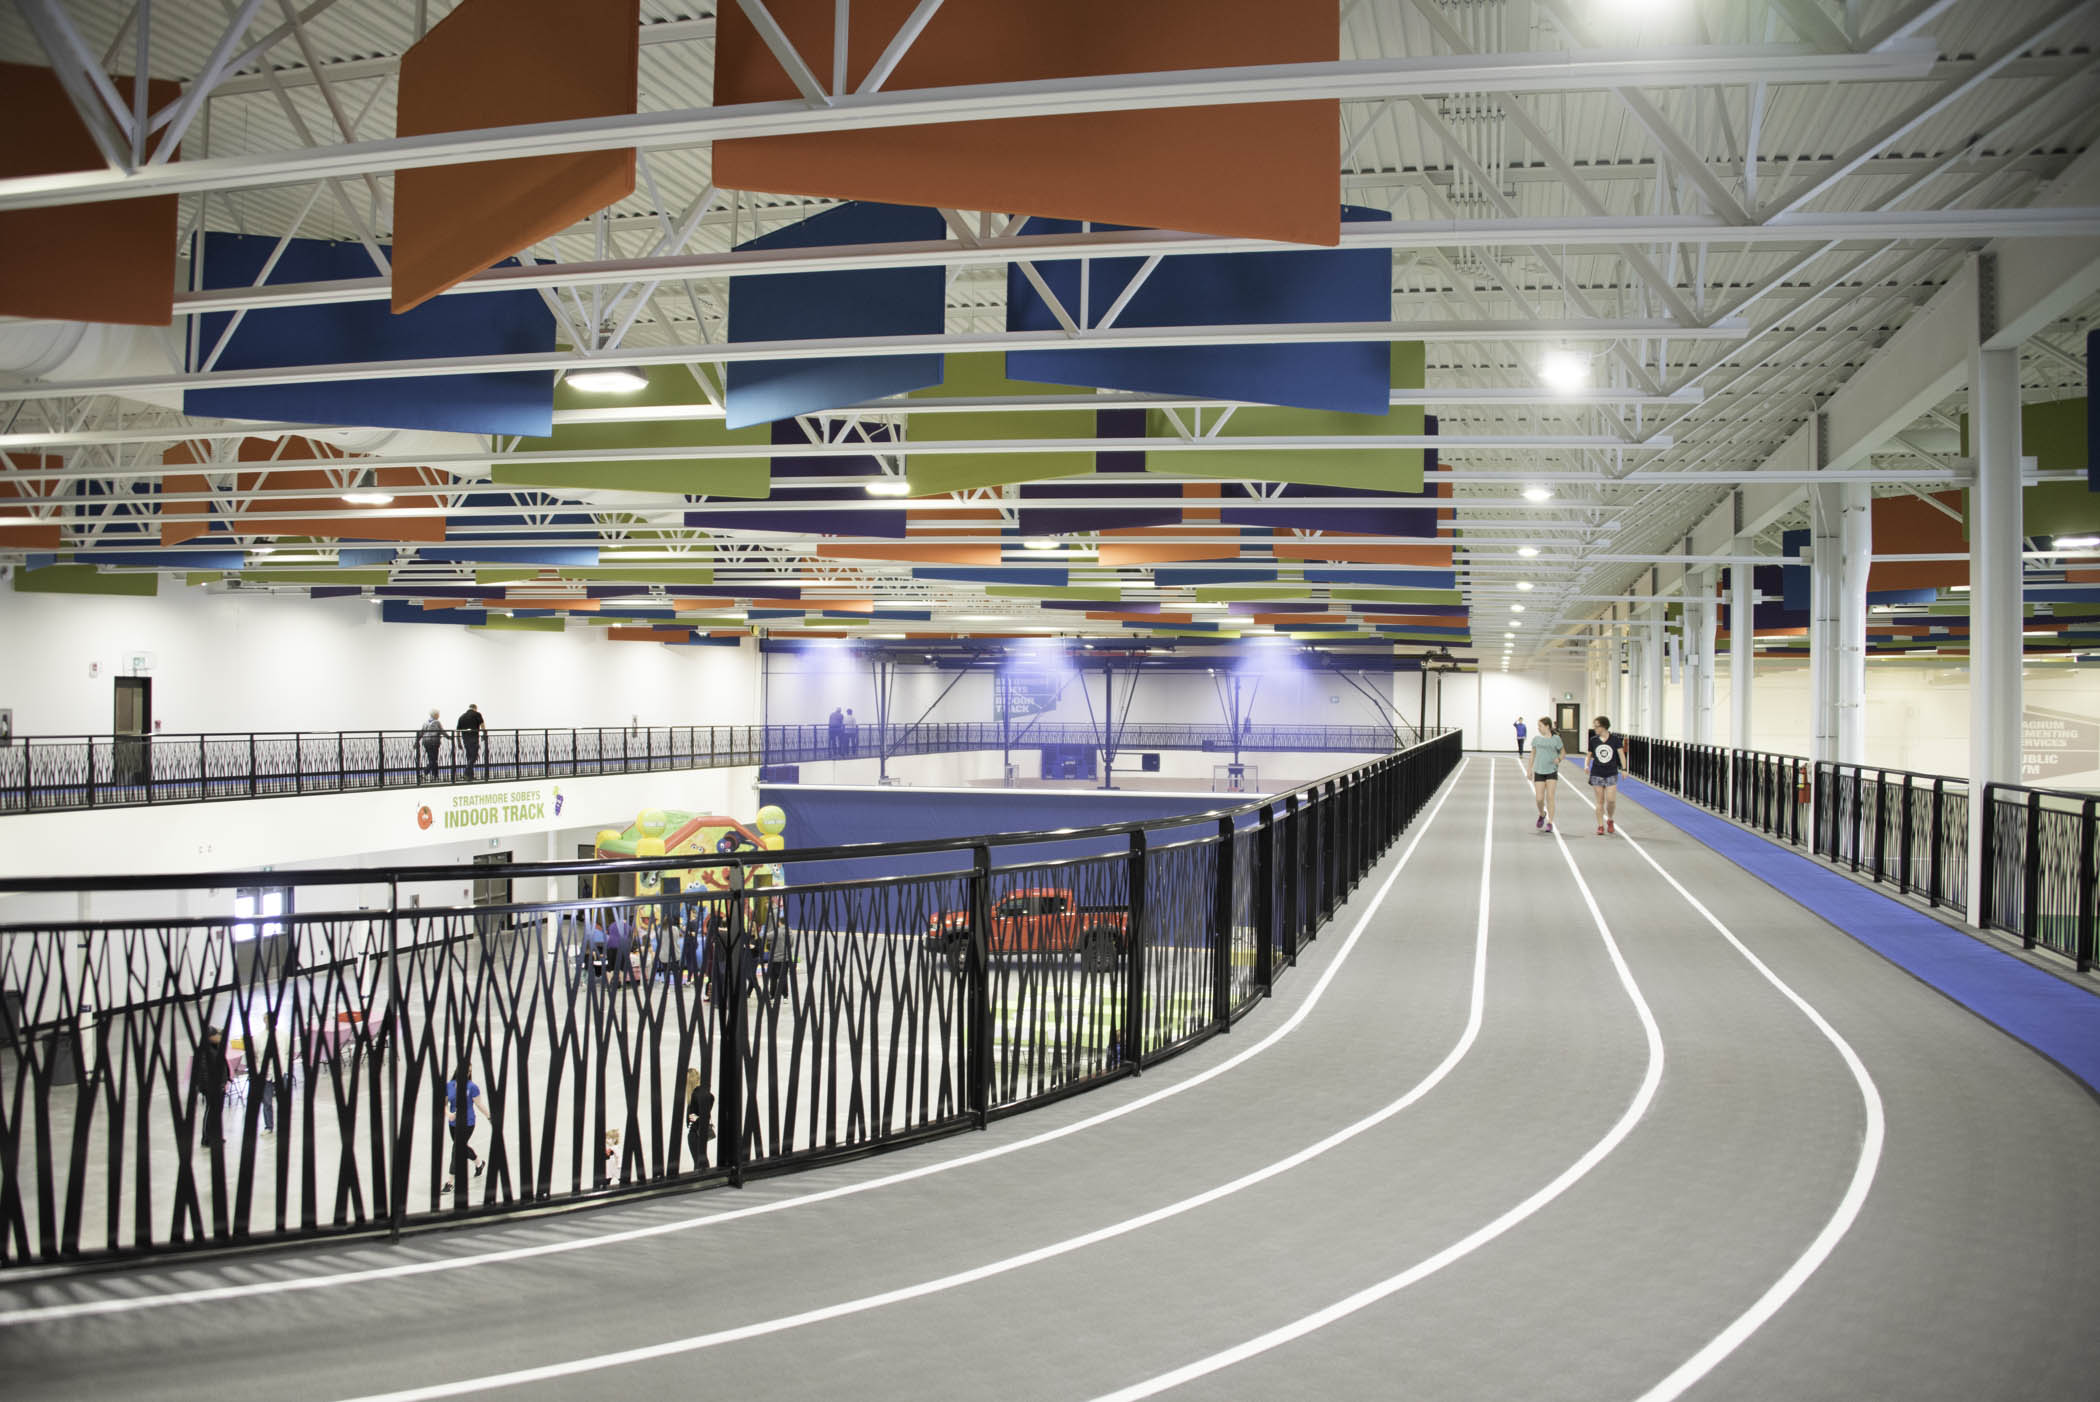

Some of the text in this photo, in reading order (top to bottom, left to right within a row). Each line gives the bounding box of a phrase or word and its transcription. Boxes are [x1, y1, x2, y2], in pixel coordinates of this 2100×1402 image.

[2023, 720, 2065, 729] AGNUM
[2023, 729, 2079, 738] MENTING
[452, 790, 541, 808] STRATHMORE SOBEYS
[444, 803, 545, 829] INDOOR TRACK
